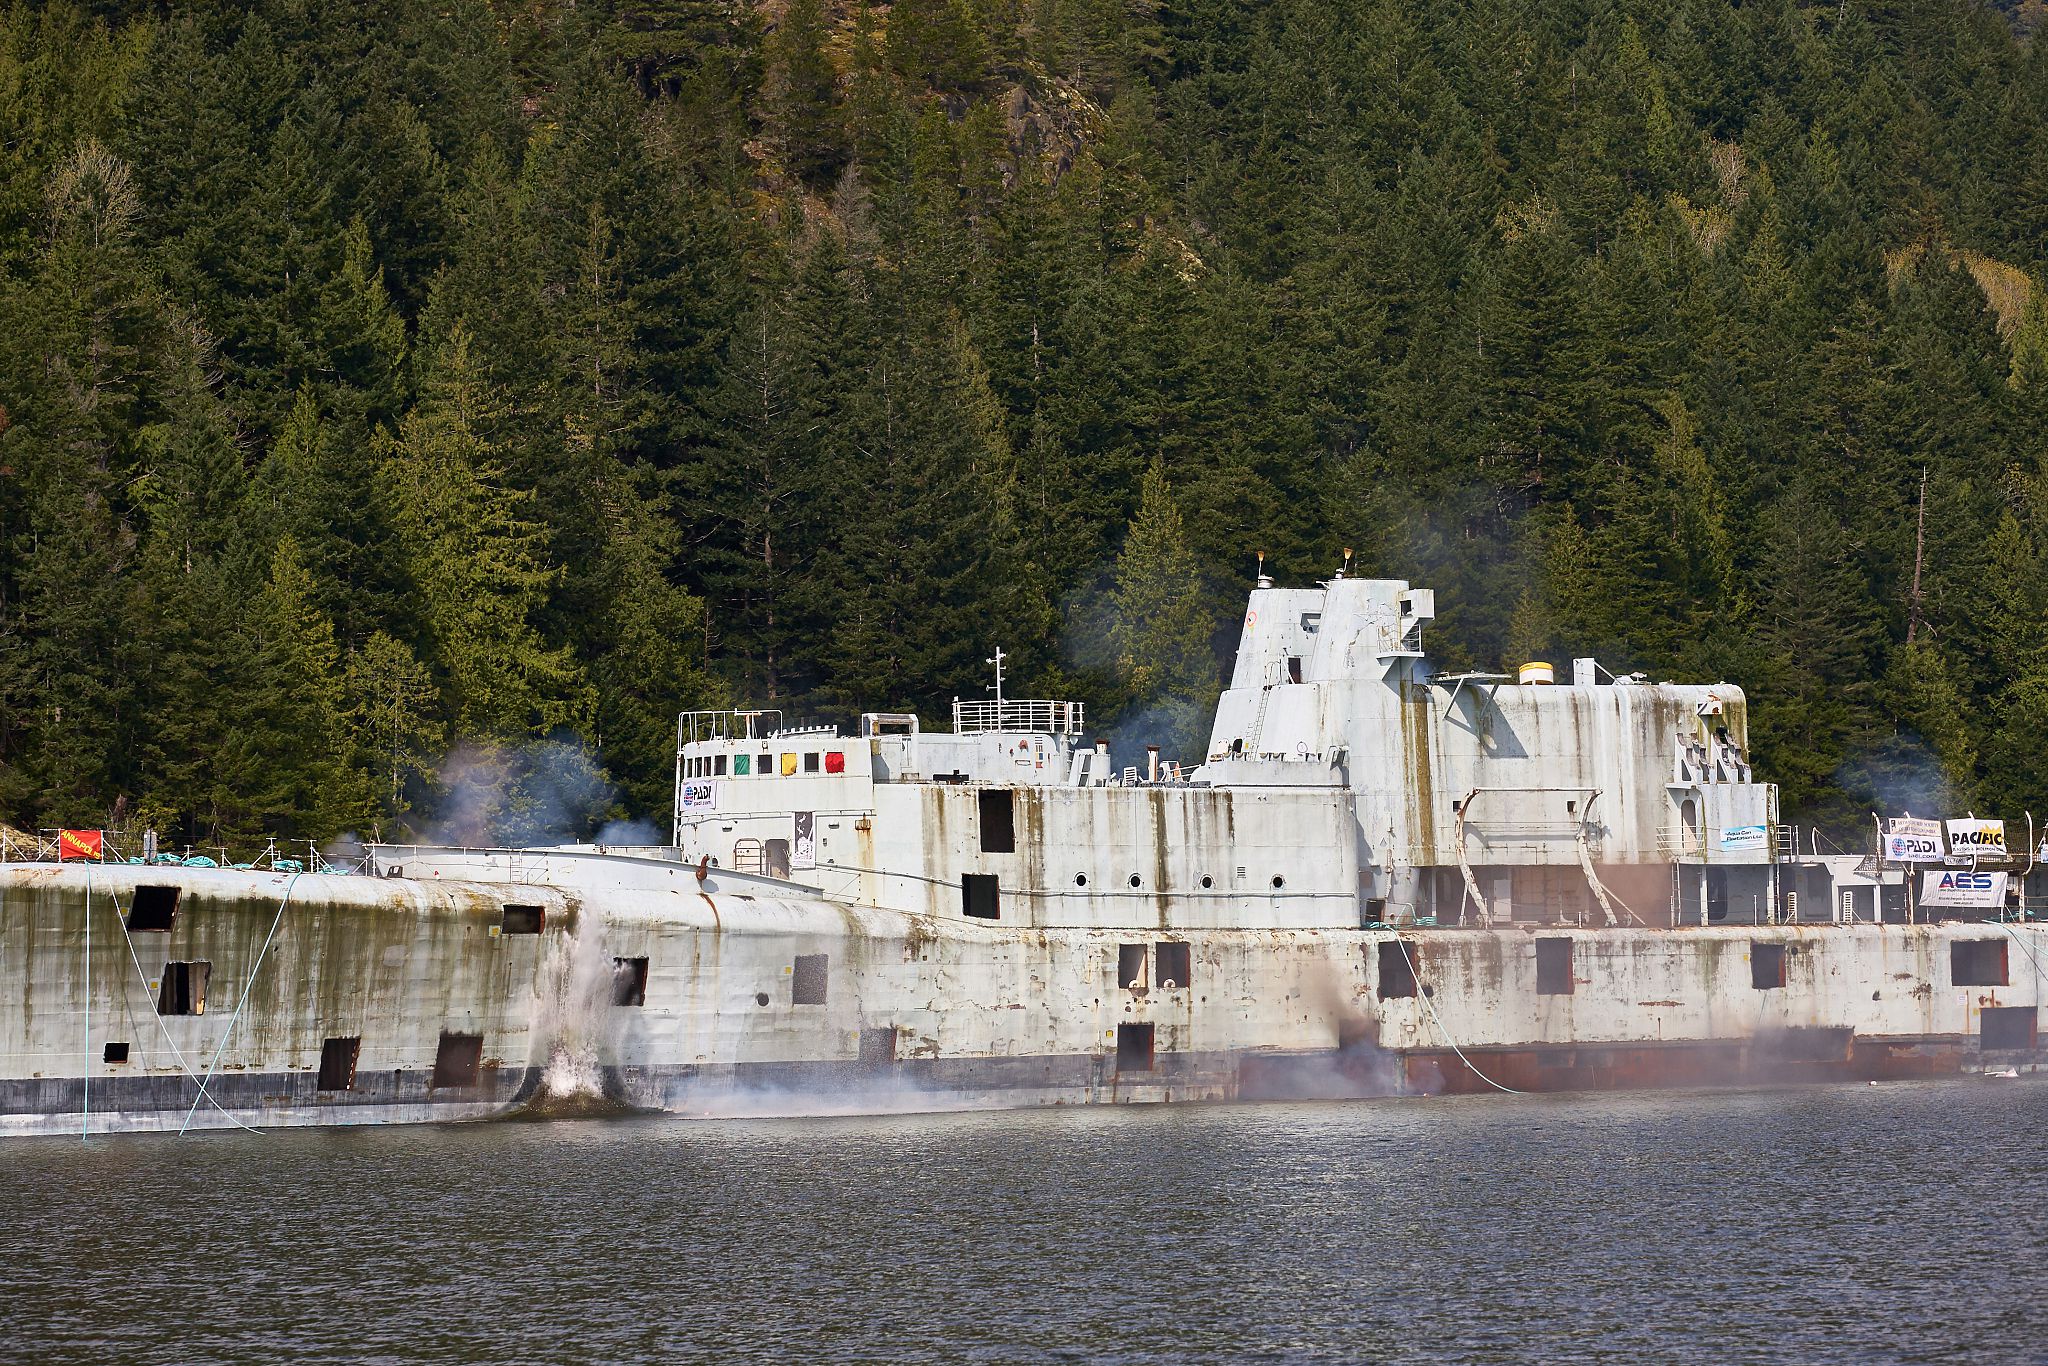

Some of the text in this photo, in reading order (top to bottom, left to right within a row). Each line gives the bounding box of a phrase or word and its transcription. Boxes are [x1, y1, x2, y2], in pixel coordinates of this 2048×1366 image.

[694, 786, 711, 800] PADI
[61, 830, 100, 859] ANNAPOLIS
[1952, 832, 2002, 845] PACIFIC
[1907, 840, 1936, 852] PADI
[1939, 872, 1992, 888] AES
